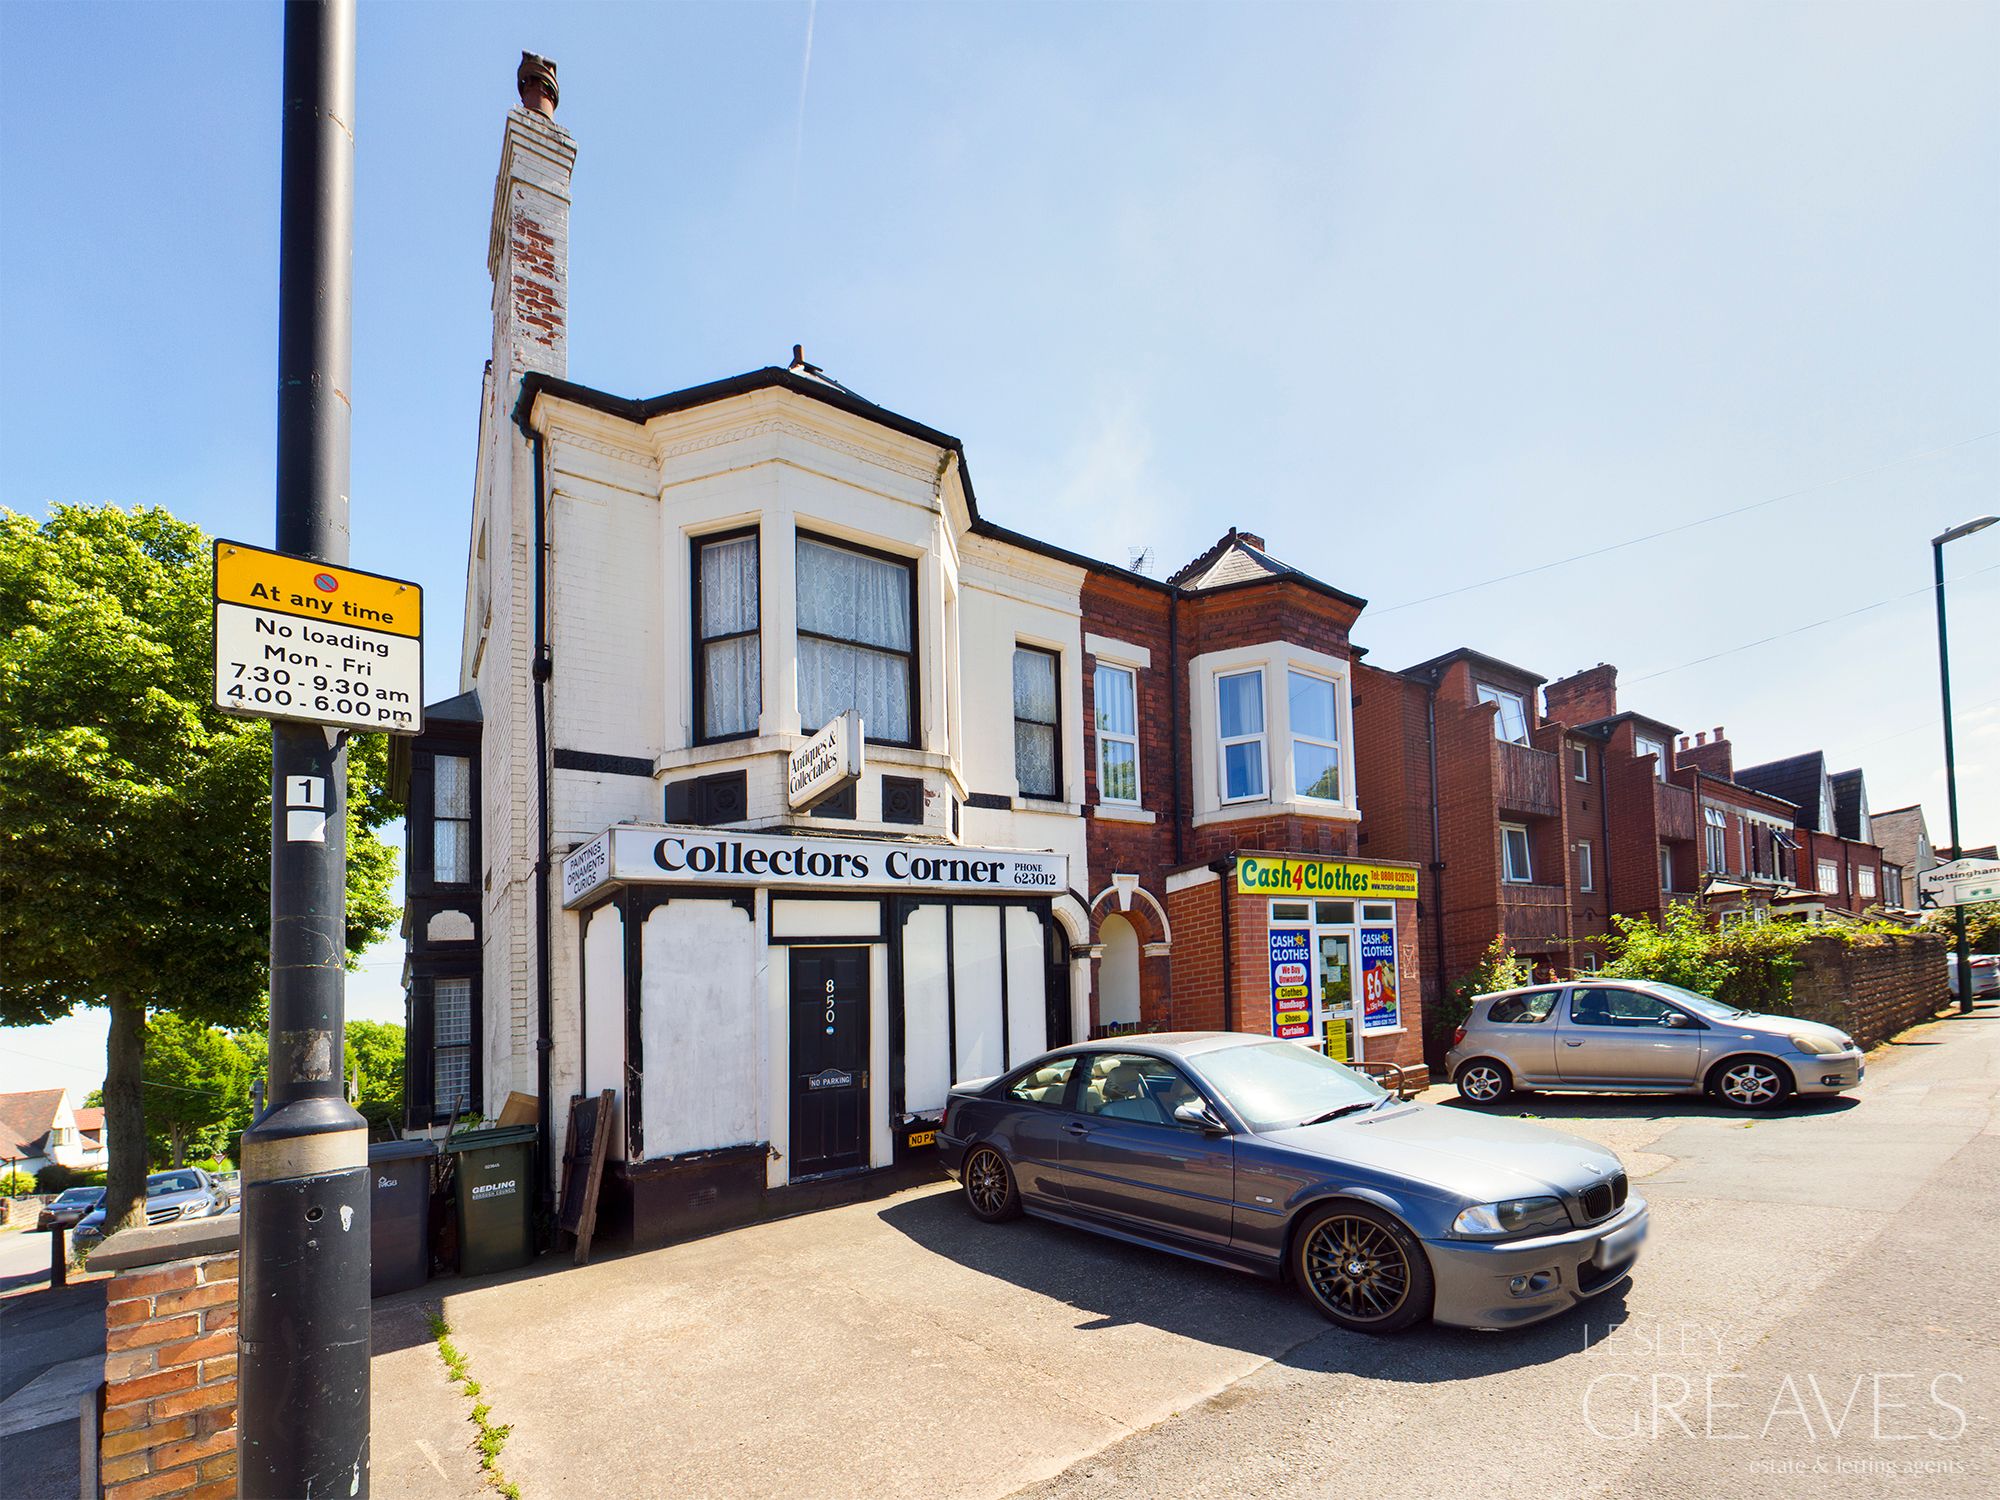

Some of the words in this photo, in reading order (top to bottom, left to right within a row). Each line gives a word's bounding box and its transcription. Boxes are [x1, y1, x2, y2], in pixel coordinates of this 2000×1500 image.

[250, 583, 281, 602] At
[290, 592, 333, 614] any
[343, 601, 394, 625] time
[255, 617, 293, 638] No
[303, 626, 389, 658] loading
[265, 644, 318, 668] Mon
[343, 658, 372, 676] Fri
[231, 662, 290, 685] 7.30
[313, 675, 369, 697] 9.30
[376, 688, 410, 703] am
[227, 683, 292, 706] 4.00
[315, 695, 371, 717] 6.00
[378, 707, 412, 722] pm
[792, 739, 827, 773] Antiques
[829, 730, 836, 748] &
[790, 752, 837, 794] Collectables
[298, 779, 311, 803] 1
[570, 842, 601, 871] PAINTINGS
[653, 837, 869, 879] Collectors
[886, 851, 1005, 883] Corner
[1014, 863, 1043, 872] PHONE
[567, 853, 605, 885] ORNAMENTS
[1014, 872, 1056, 885] 623012
[1929, 868, 2000, 882] Nottingham
[574, 871, 596, 894] CURIOS
[1271, 935, 1294, 948] CASH
[1362, 934, 1381, 945] CASH
[1362, 945, 1393, 957] CLOTHES
[1272, 948, 1309, 961] CLOTHES
[1281, 988, 1303, 997] Clothes
[1367, 970, 1382, 1000] £6
[825, 979, 835, 1023] 850
[822, 1077, 850, 1086] PARKING
[912, 1135, 923, 1144] NO
[472, 1180, 516, 1194] GEDLING
